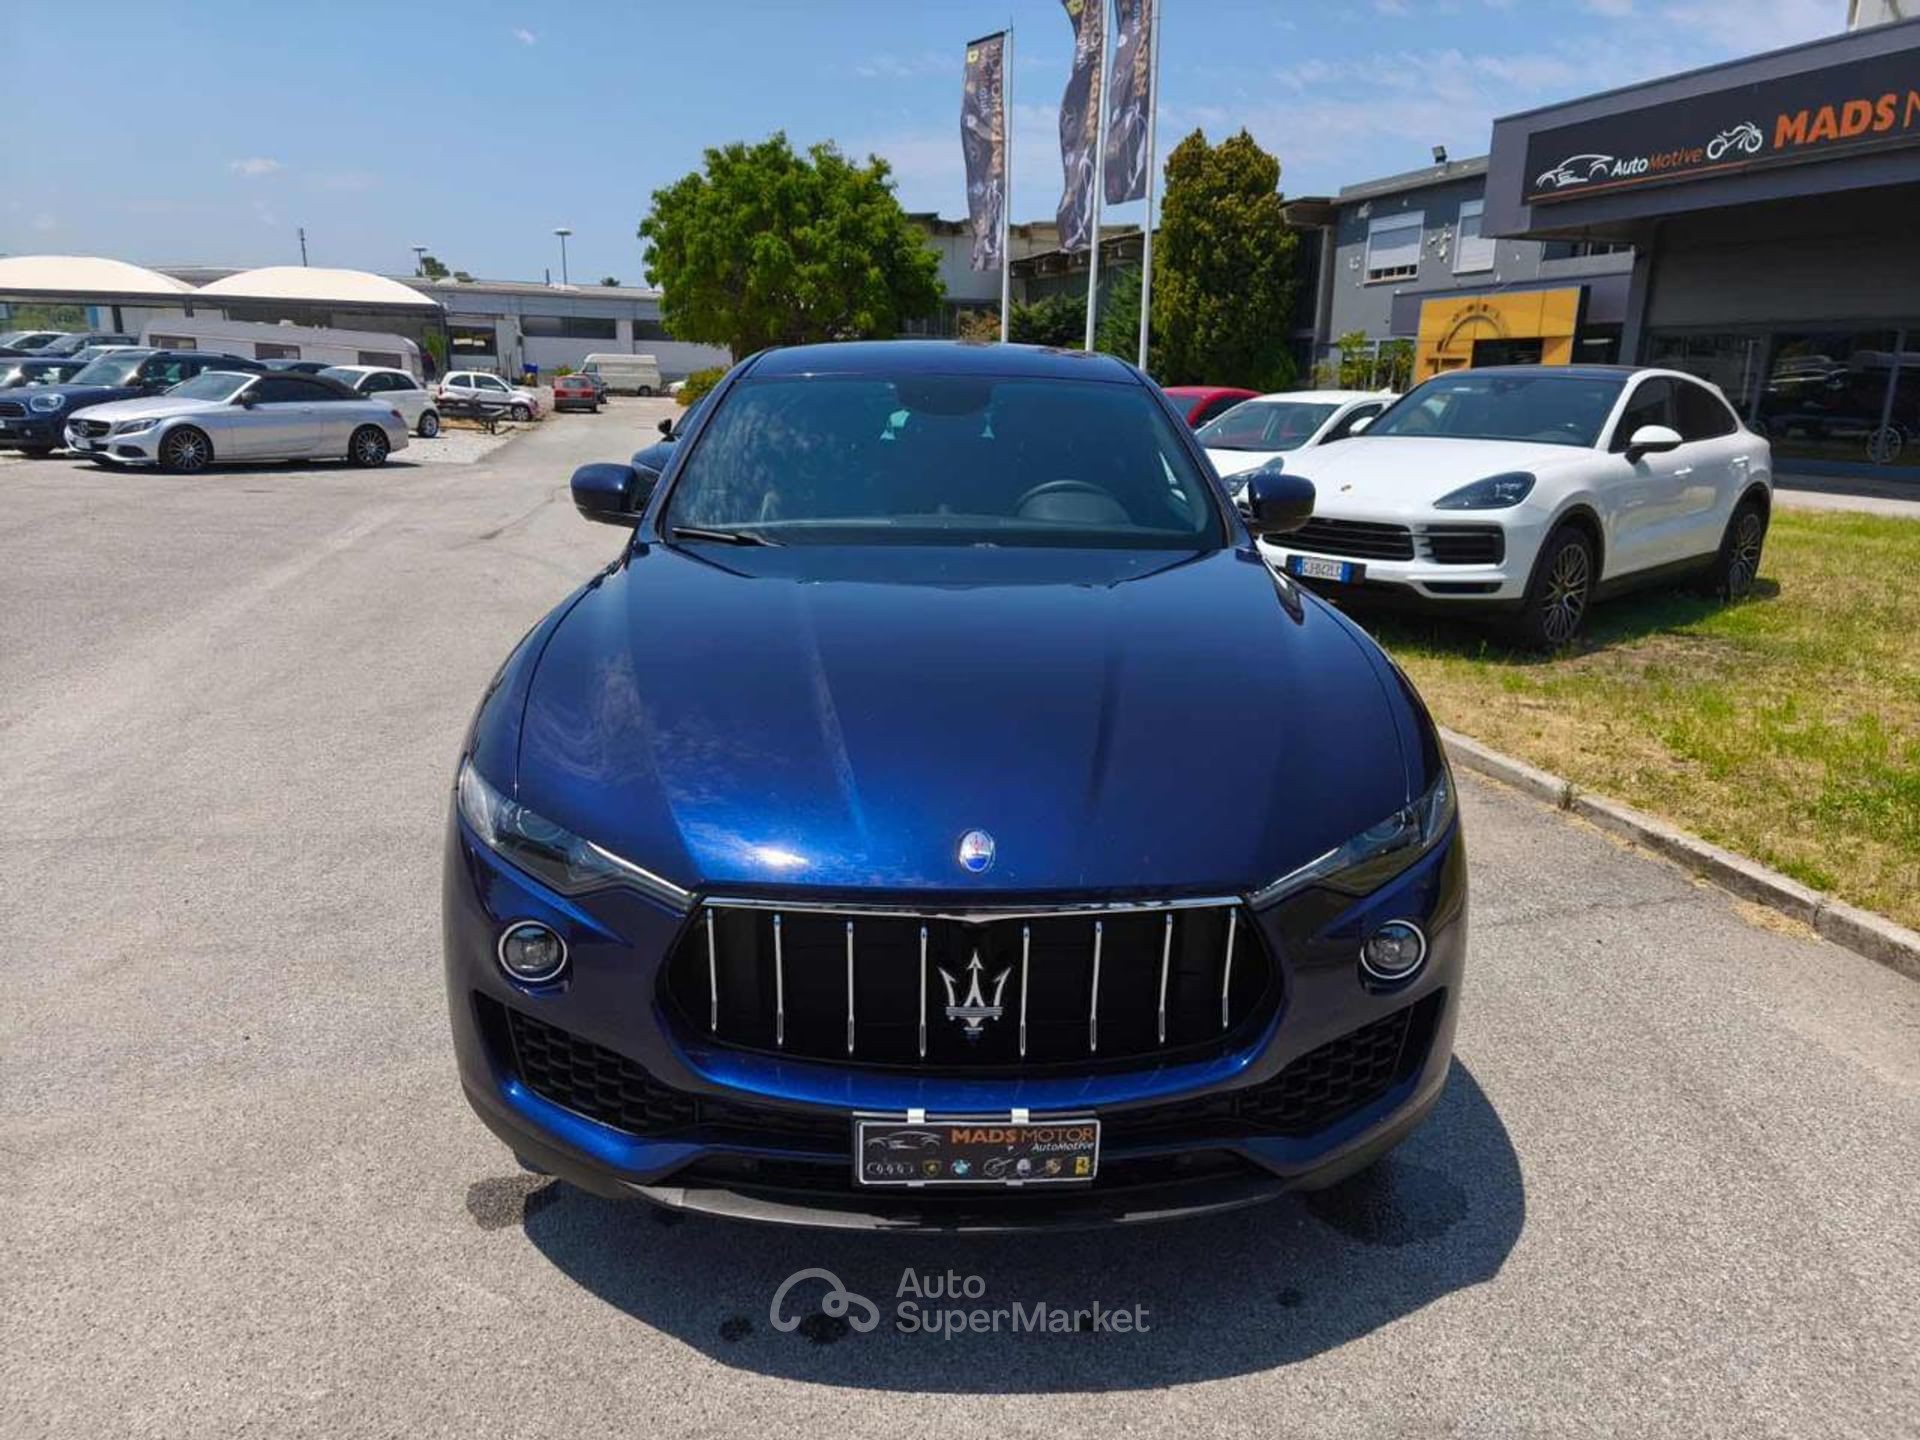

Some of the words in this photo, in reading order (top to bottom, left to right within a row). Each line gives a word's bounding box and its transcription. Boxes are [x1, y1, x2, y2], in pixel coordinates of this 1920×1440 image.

[1774, 93, 1897, 149] MADS
[952, 1127, 1018, 1144] MADS
[1021, 1127, 1095, 1143] MOTOR
